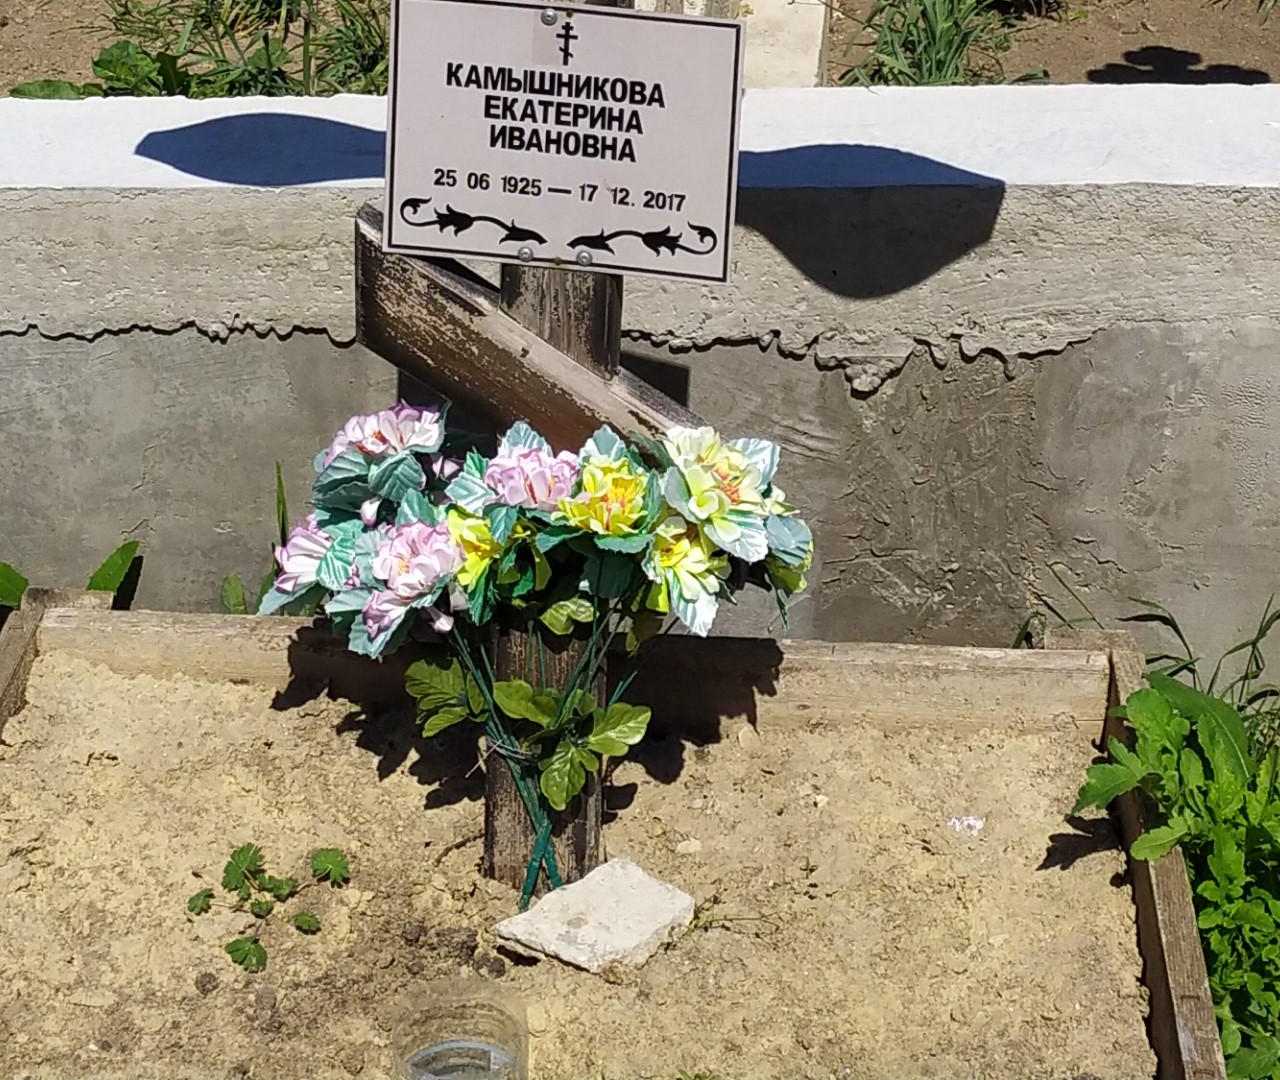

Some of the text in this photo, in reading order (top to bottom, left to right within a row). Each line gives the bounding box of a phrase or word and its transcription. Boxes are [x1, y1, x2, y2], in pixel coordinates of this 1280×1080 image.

[446, 62, 665, 108] КАМЫШНИКОВА
[484, 95, 643, 134] ЕКАТЕРИНА
[489, 124, 636, 162] ИВАНОВНА
[434, 169, 457, 186] 25
[467, 173, 490, 190] 06
[501, 176, 542, 196] 1925
[579, 184, 598, 202] 17
[643, 190, 686, 211] 2017
